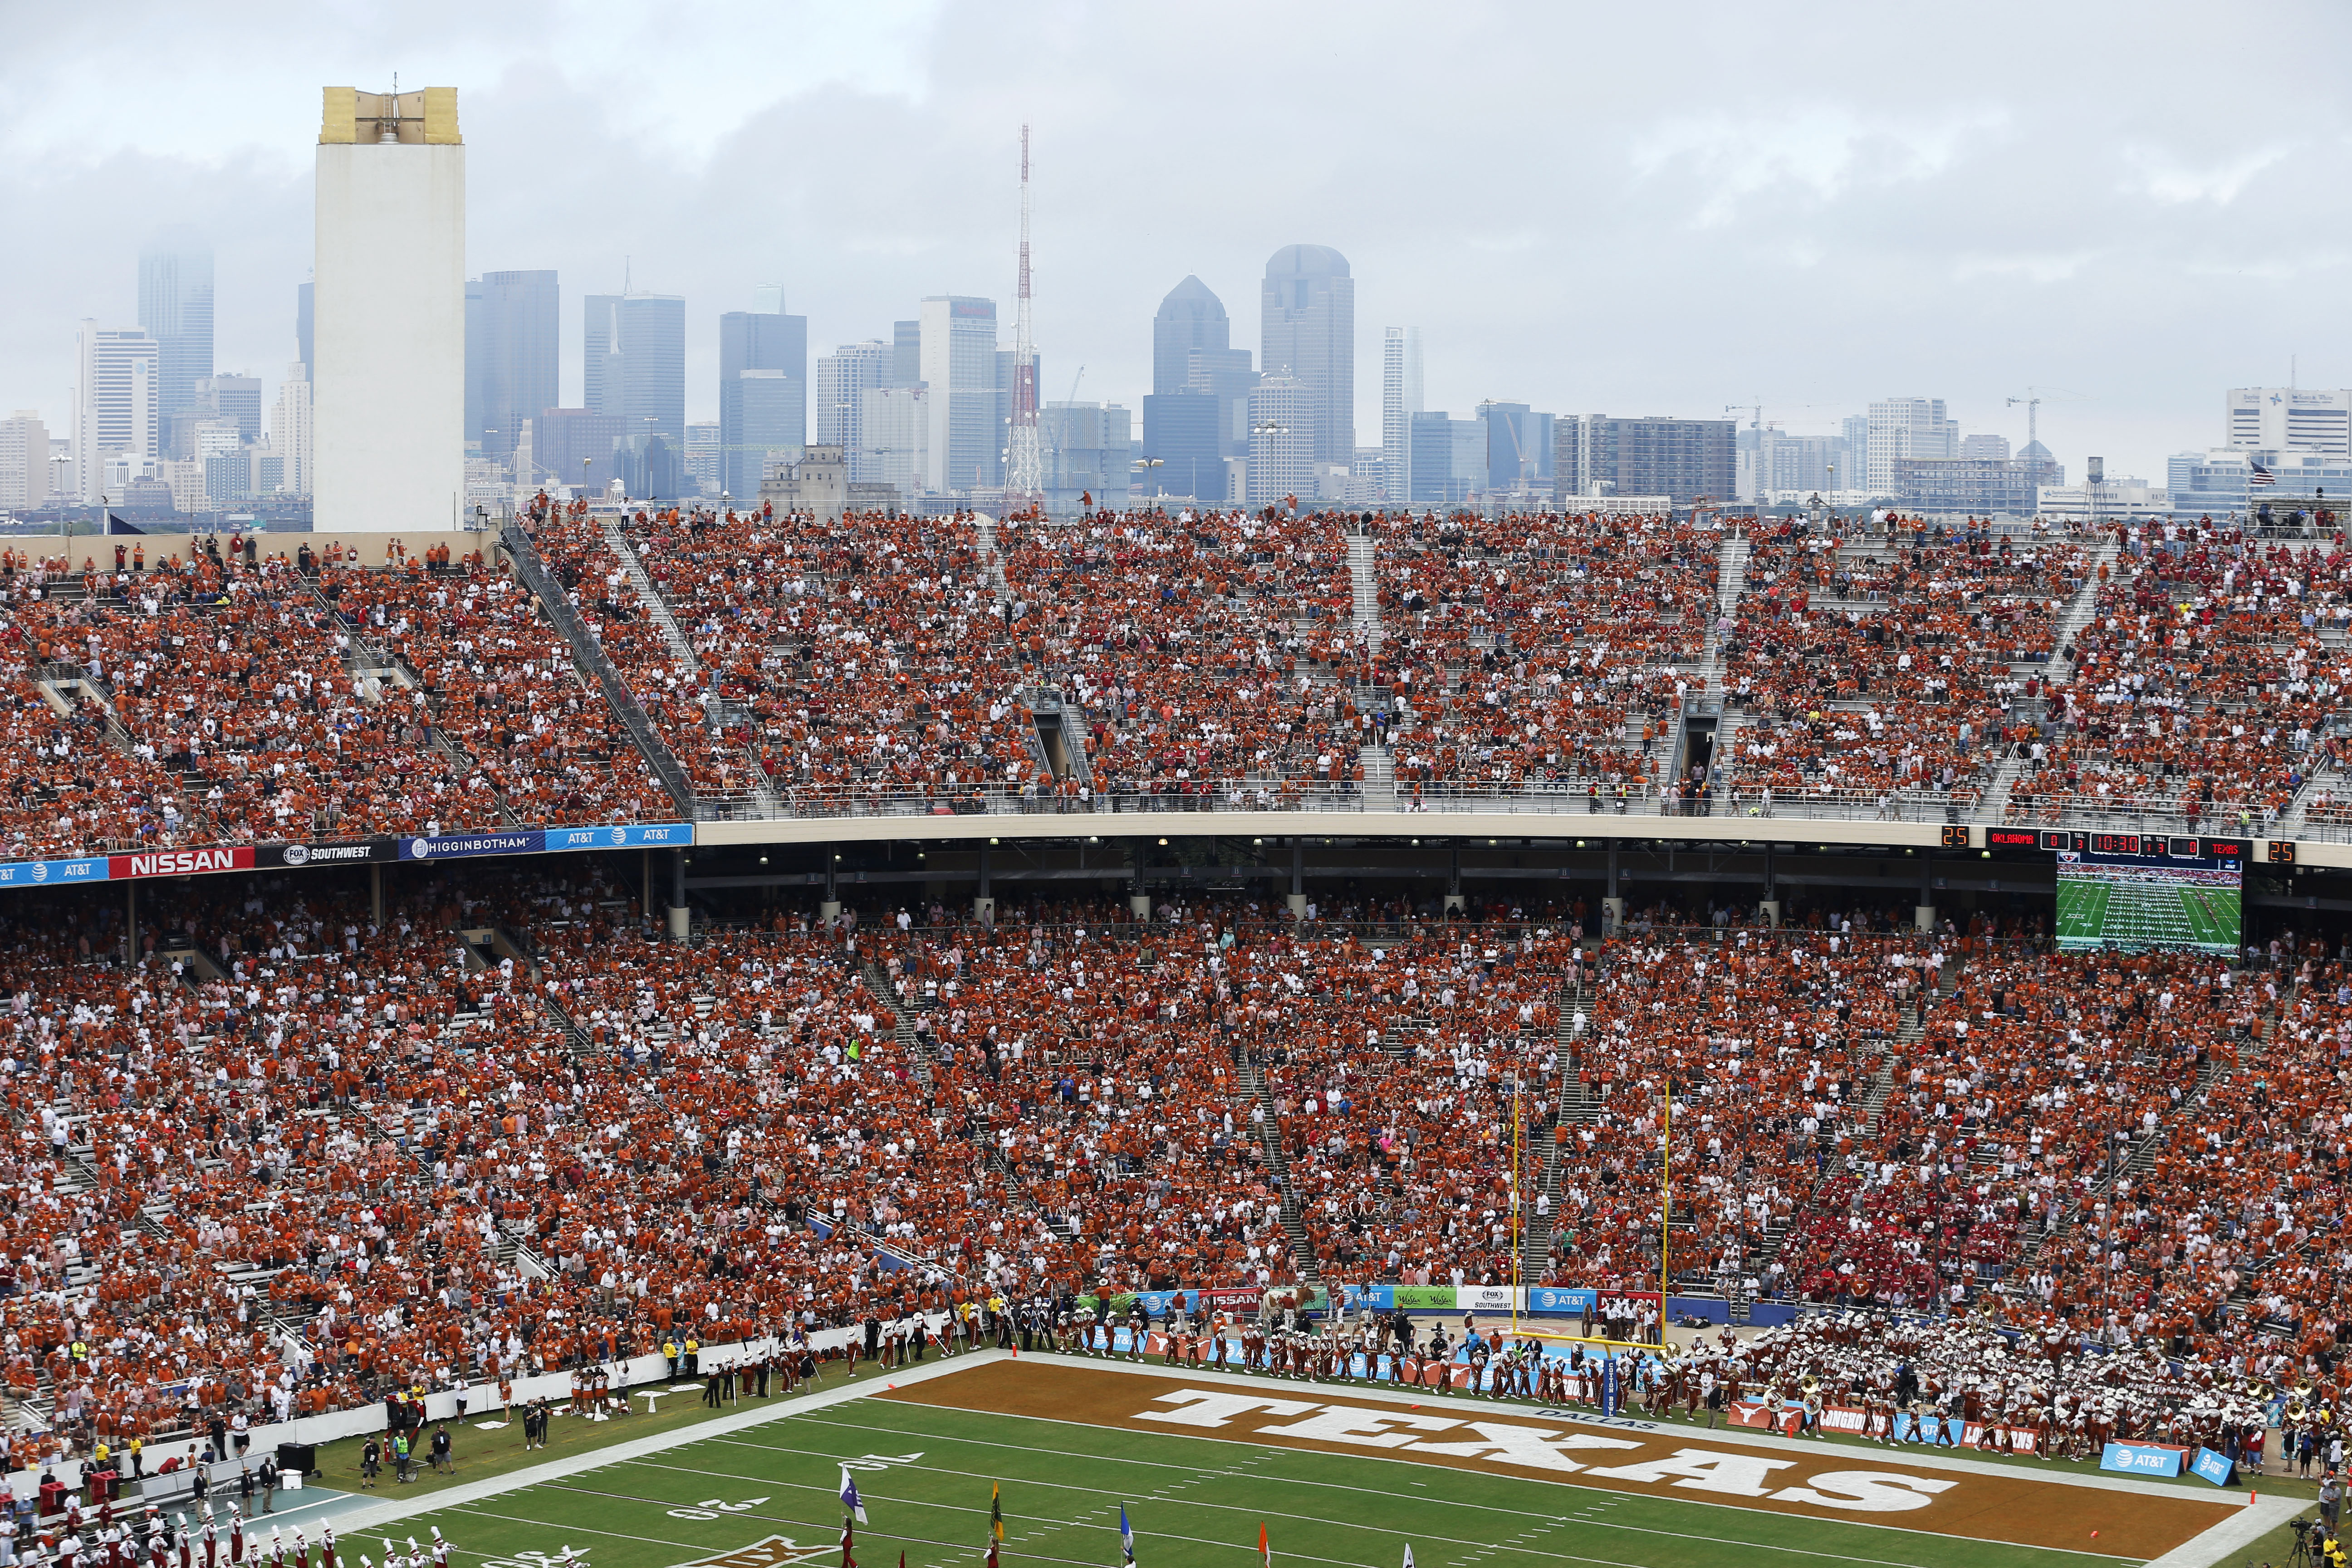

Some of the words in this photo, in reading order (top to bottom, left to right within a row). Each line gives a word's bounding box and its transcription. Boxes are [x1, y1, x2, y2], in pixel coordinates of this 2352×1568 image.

[568, 832, 594, 844] AT&T
[643, 829, 670, 840] AT&T
[1944, 828, 1966, 844] 25
[1992, 833, 2034, 844] OKLAHOMA
[2050, 835, 2058, 846] 0
[2077, 839, 2083, 849] 3
[2098, 836, 2137, 852] 10:30
[289, 849, 304, 857] FOX
[2147, 843, 2151, 852] 1
[2158, 843, 2164, 853] 3
[2189, 842, 2196, 853] 0
[2212, 844, 2238, 854] TEXAS
[2270, 843, 2292, 861] 25
[131, 849, 233, 875] NISSAN
[64, 863, 91, 876] AT&T
[1558, 1296, 1585, 1305] AT&T
[1534, 1410, 1659, 1429] DALLAS
[1130, 1388, 1960, 1511] TEXAS
[2134, 1455, 2167, 1468] AT&T
[2208, 1460, 2225, 1475] AT&T
